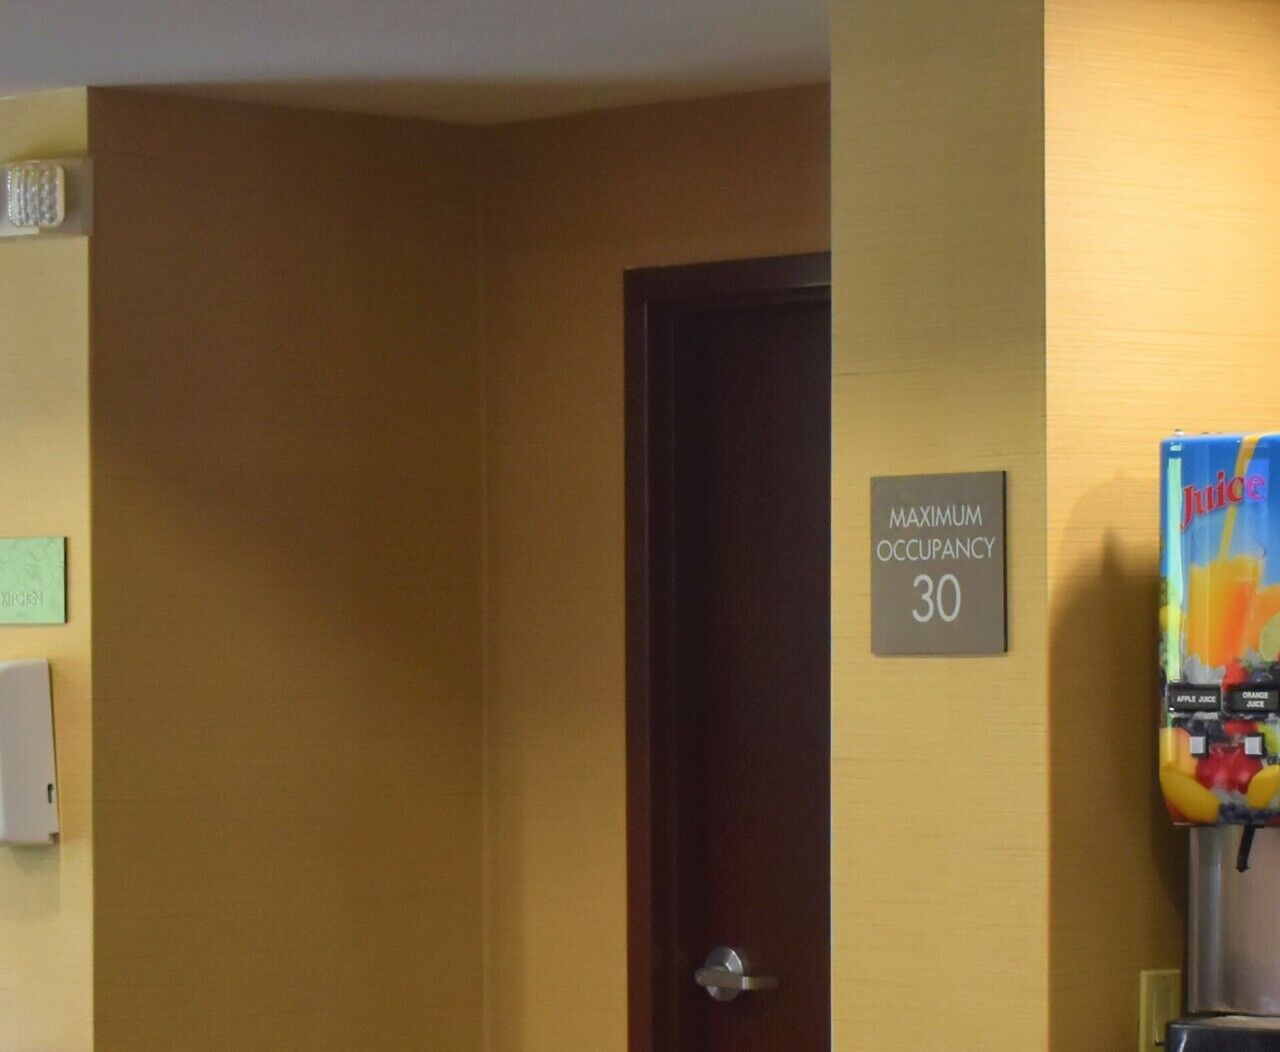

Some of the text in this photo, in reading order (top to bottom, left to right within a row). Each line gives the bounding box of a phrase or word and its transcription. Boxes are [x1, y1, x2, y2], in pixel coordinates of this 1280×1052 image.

[1179, 469, 1265, 533] Juice
[889, 504, 982, 528] MAXIMUM
[876, 536, 996, 562] OCCUPANCY
[912, 573, 962, 622] 30
[1176, 695, 1217, 703] APPLE JUICE
[1242, 691, 1269, 699] ORANGE
[1246, 700, 1265, 708] JUICE
